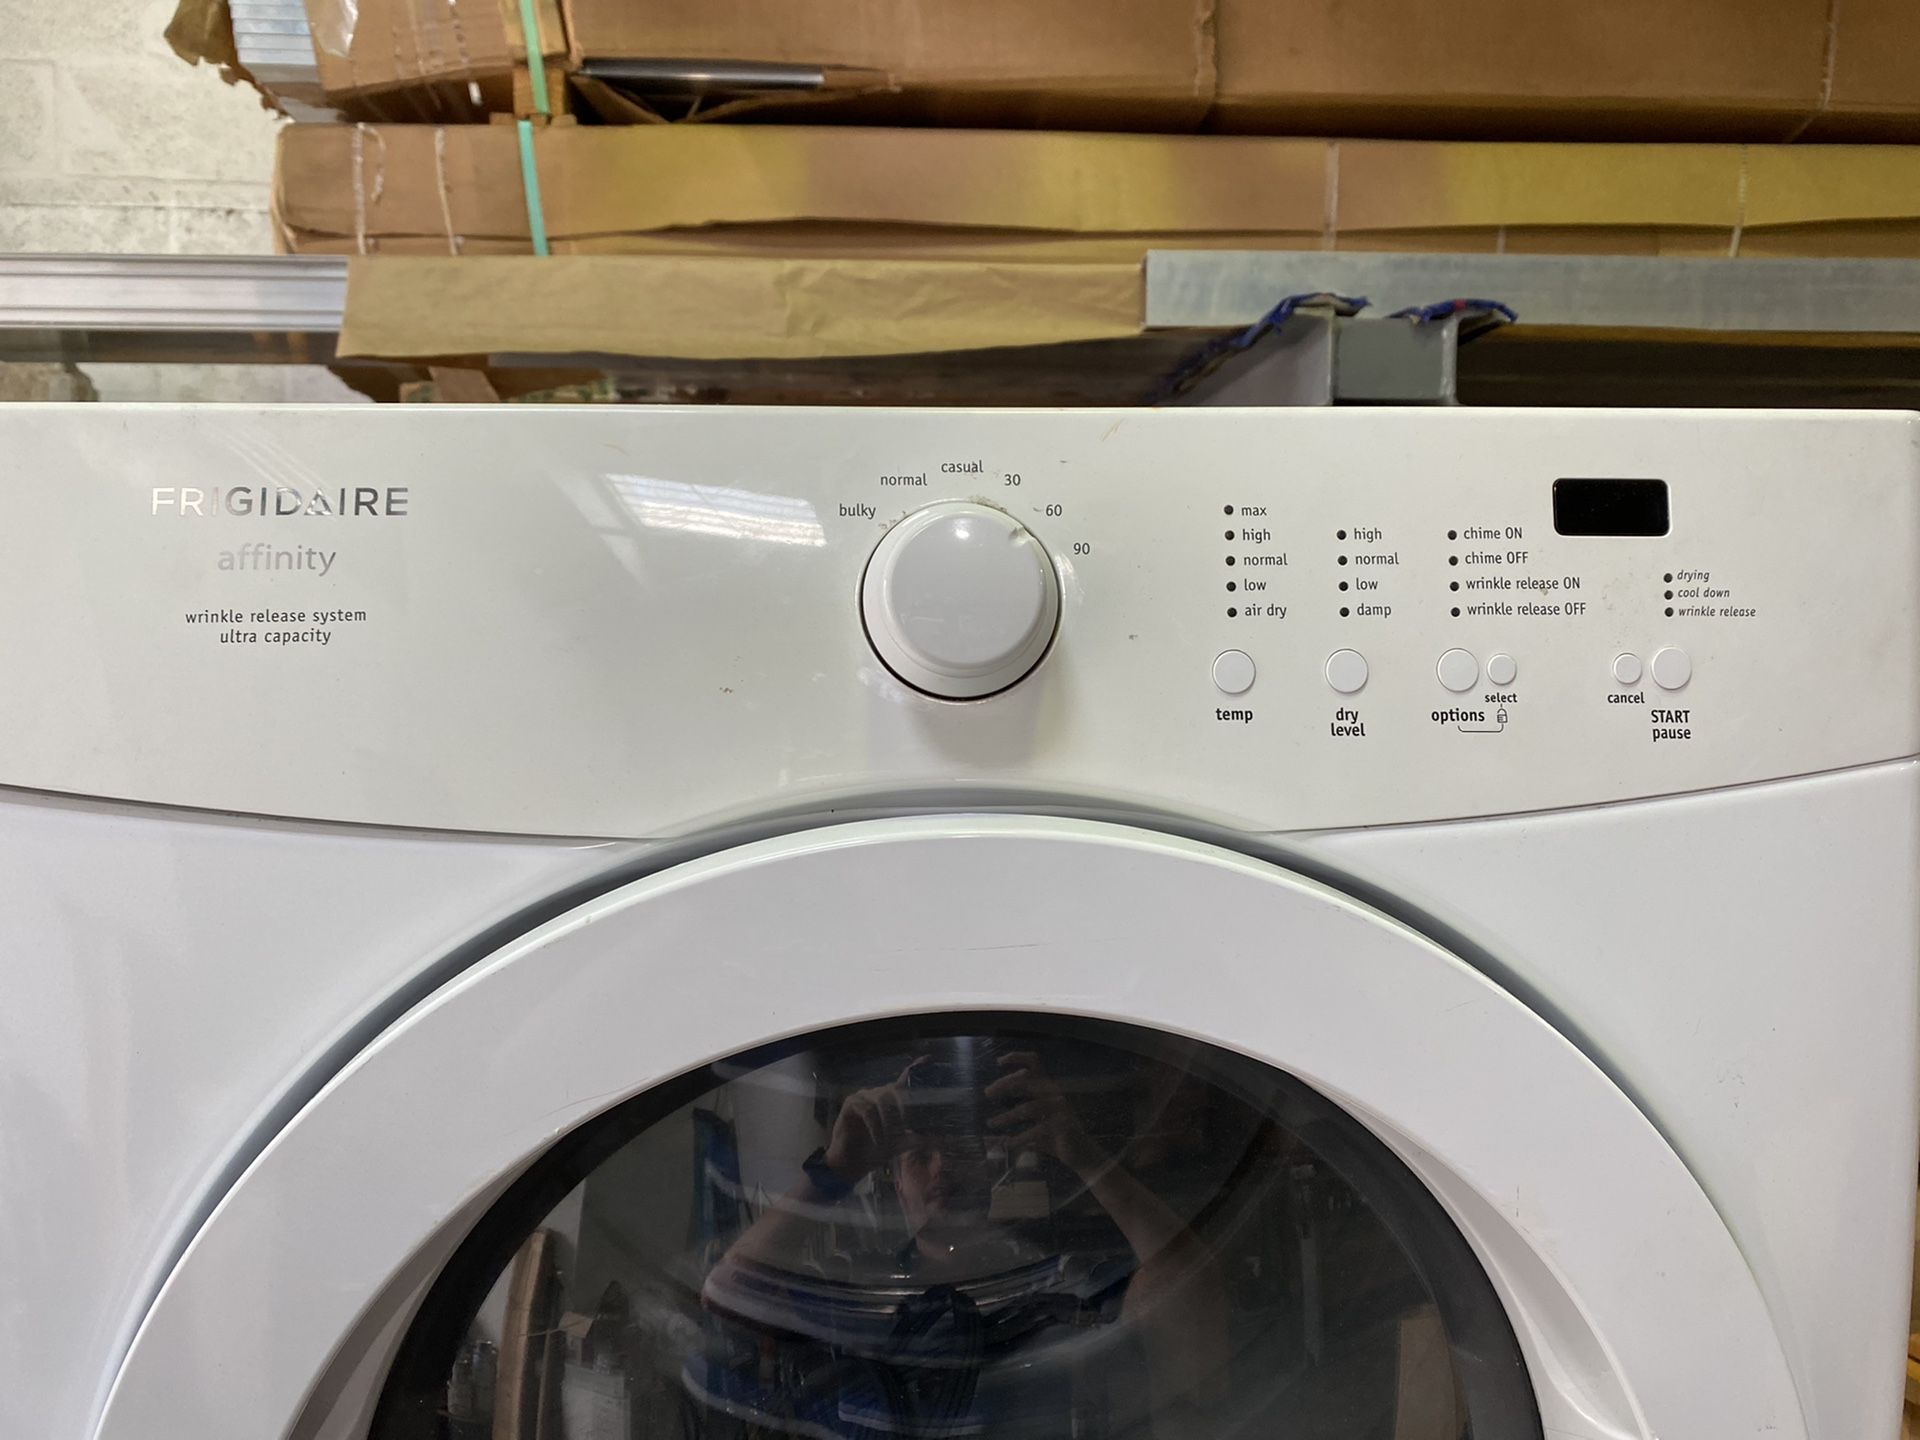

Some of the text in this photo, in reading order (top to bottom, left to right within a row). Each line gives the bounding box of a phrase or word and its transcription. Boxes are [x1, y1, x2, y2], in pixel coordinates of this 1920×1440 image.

[940, 460, 984, 473] casual
[880, 473, 928, 486] normal
[1004, 473, 1021, 486] 30
[151, 486, 409, 517] FRIGIDAIRE
[839, 503, 877, 519] bulky
[1045, 504, 1063, 517] 60
[1241, 505, 1267, 516] max
[1242, 528, 1271, 542] high
[1353, 527, 1383, 541] high
[1463, 527, 1523, 540] chime ON
[1073, 542, 1091, 555] 90
[217, 542, 337, 577] affinity
[1243, 553, 1288, 567] normal
[1354, 552, 1400, 566] normal
[1464, 551, 1529, 565] chime OFF
[1677, 569, 1710, 583] drying
[1243, 578, 1267, 592] low
[1355, 578, 1379, 591] low
[1465, 577, 1581, 590] wrinkle release ON
[1677, 587, 1730, 598] cool down
[1244, 603, 1288, 620] air dry
[1356, 603, 1392, 618] damp
[1467, 602, 1587, 616] wrinkle release OFF
[1678, 605, 1756, 617] wrinkle release
[185, 609, 367, 625] wrinkle release system
[219, 629, 332, 645] ultra capacity
[1484, 691, 1518, 704] select
[1607, 691, 1645, 704] cancel
[1215, 708, 1254, 724] temp
[1335, 707, 1359, 724] dry
[1431, 708, 1486, 724] options
[1650, 710, 1691, 724] START
[1330, 722, 1366, 737] level
[1652, 726, 1692, 742] pause
